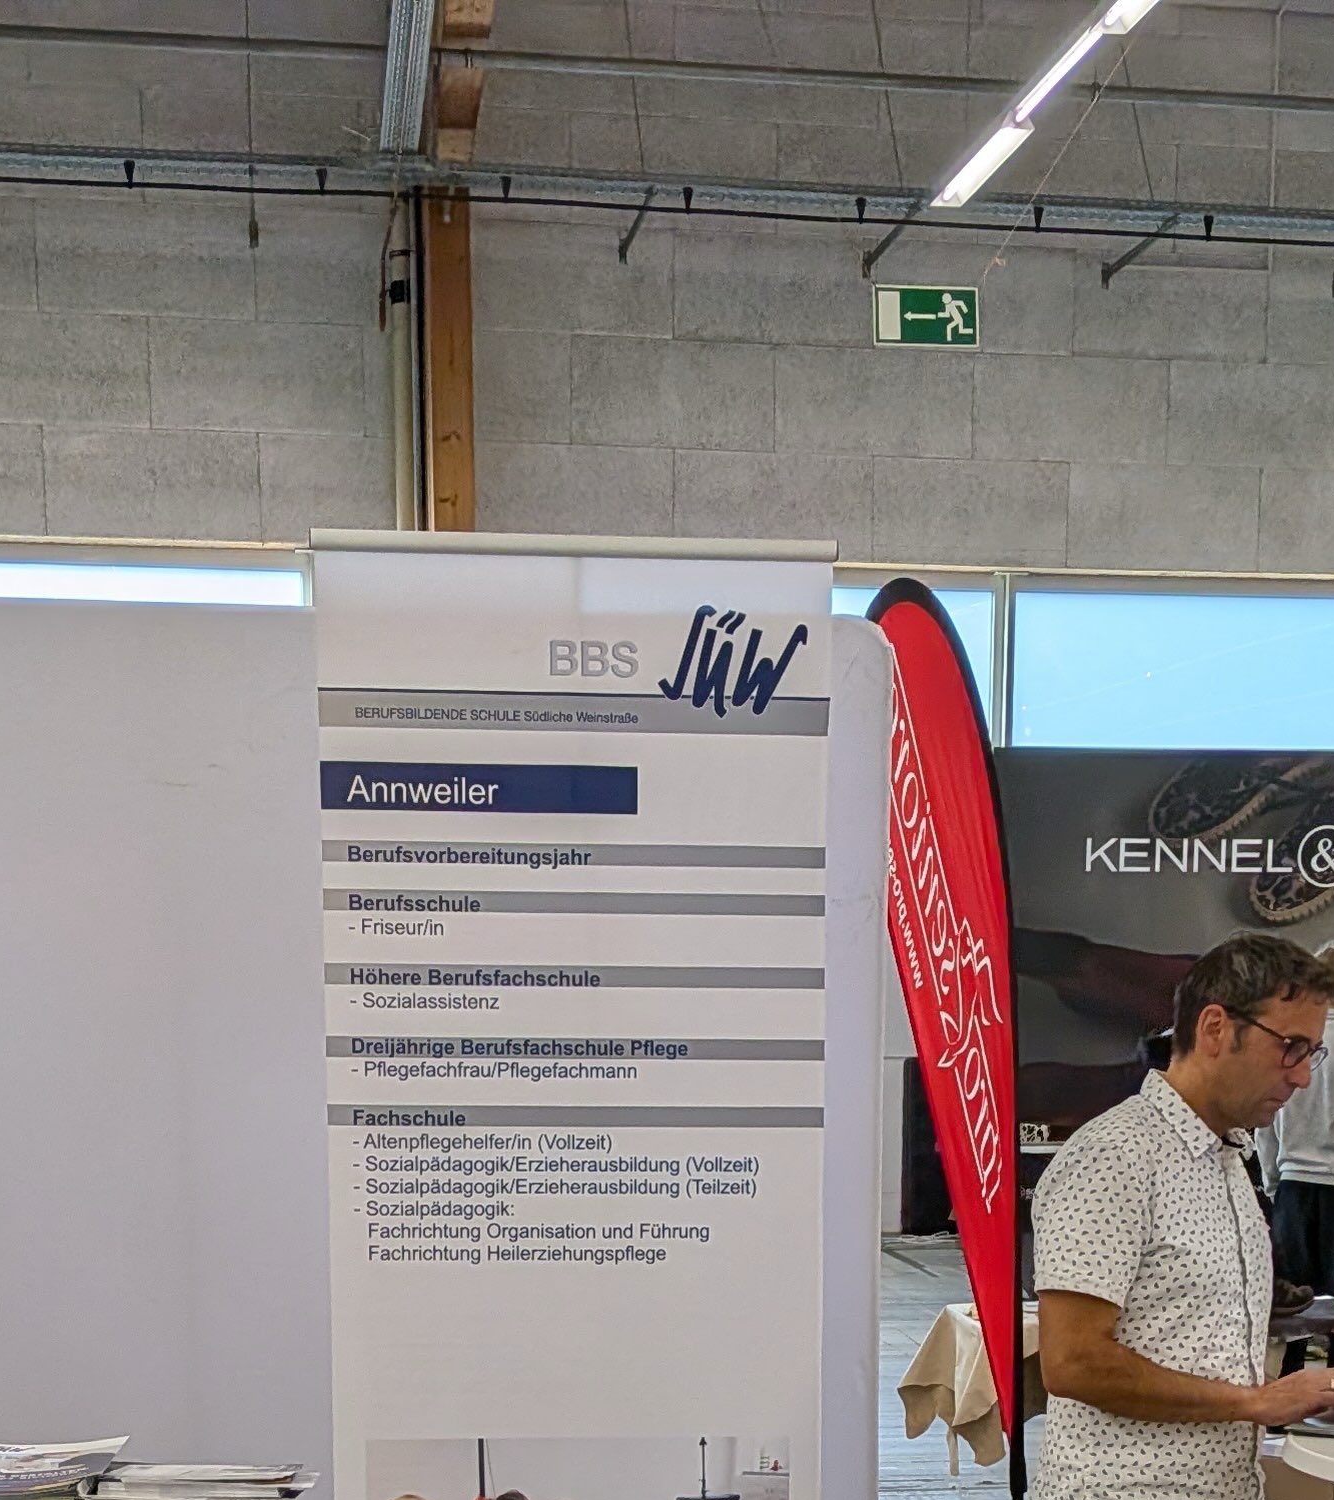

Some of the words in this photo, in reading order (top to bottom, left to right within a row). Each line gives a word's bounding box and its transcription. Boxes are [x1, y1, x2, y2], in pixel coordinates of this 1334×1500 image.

[549, 640, 640, 678] BBS
[355, 706, 467, 722] BERUFSBILDENDE
[470, 709, 521, 724] SCHULE
[524, 710, 572, 724] Südliche
[576, 711, 639, 725] Weinstraße
[346, 774, 499, 804] Annweiler
[347, 846, 592, 869] Berufsvorbereitungsjahr
[1085, 837, 1293, 873] KENNEL
[348, 894, 480, 914] Berufsschule
[362, 919, 443, 935] Friseur/in
[349, 967, 421, 987] Höhere
[428, 969, 600, 988] Berufsfachschule
[363, 992, 499, 1009] Sozialassistenz
[351, 1038, 455, 1059] Dreijährige
[460, 1038, 624, 1058] Berufsfachschule
[630, 1039, 689, 1060] Pflege
[365, 1061, 636, 1082] Pflegefachfrau/Pflegefachmann
[352, 1109, 466, 1128] Fachschule
[364, 1134, 531, 1153] Altenpflegehelfer/in
[538, 1134, 611, 1153] (Vollzeit)
[366, 1156, 679, 1176] Sozialpädagogik/Erzieherausbildung
[687, 1157, 759, 1176] (Vollzeit)
[366, 1178, 679, 1198] Sozialpädagogik/Erzieherausbildung
[687, 1179, 756, 1198] (Teilzeit)
[367, 1201, 514, 1220] Sozialpädagogik:
[369, 1223, 480, 1242] Fachrichtung
[487, 1223, 595, 1242] Organisation
[603, 1224, 633, 1239] und
[640, 1224, 709, 1242] Führung
[369, 1245, 480, 1264] Fachrichtung
[488, 1246, 666, 1265] Heilerziehungspflege
